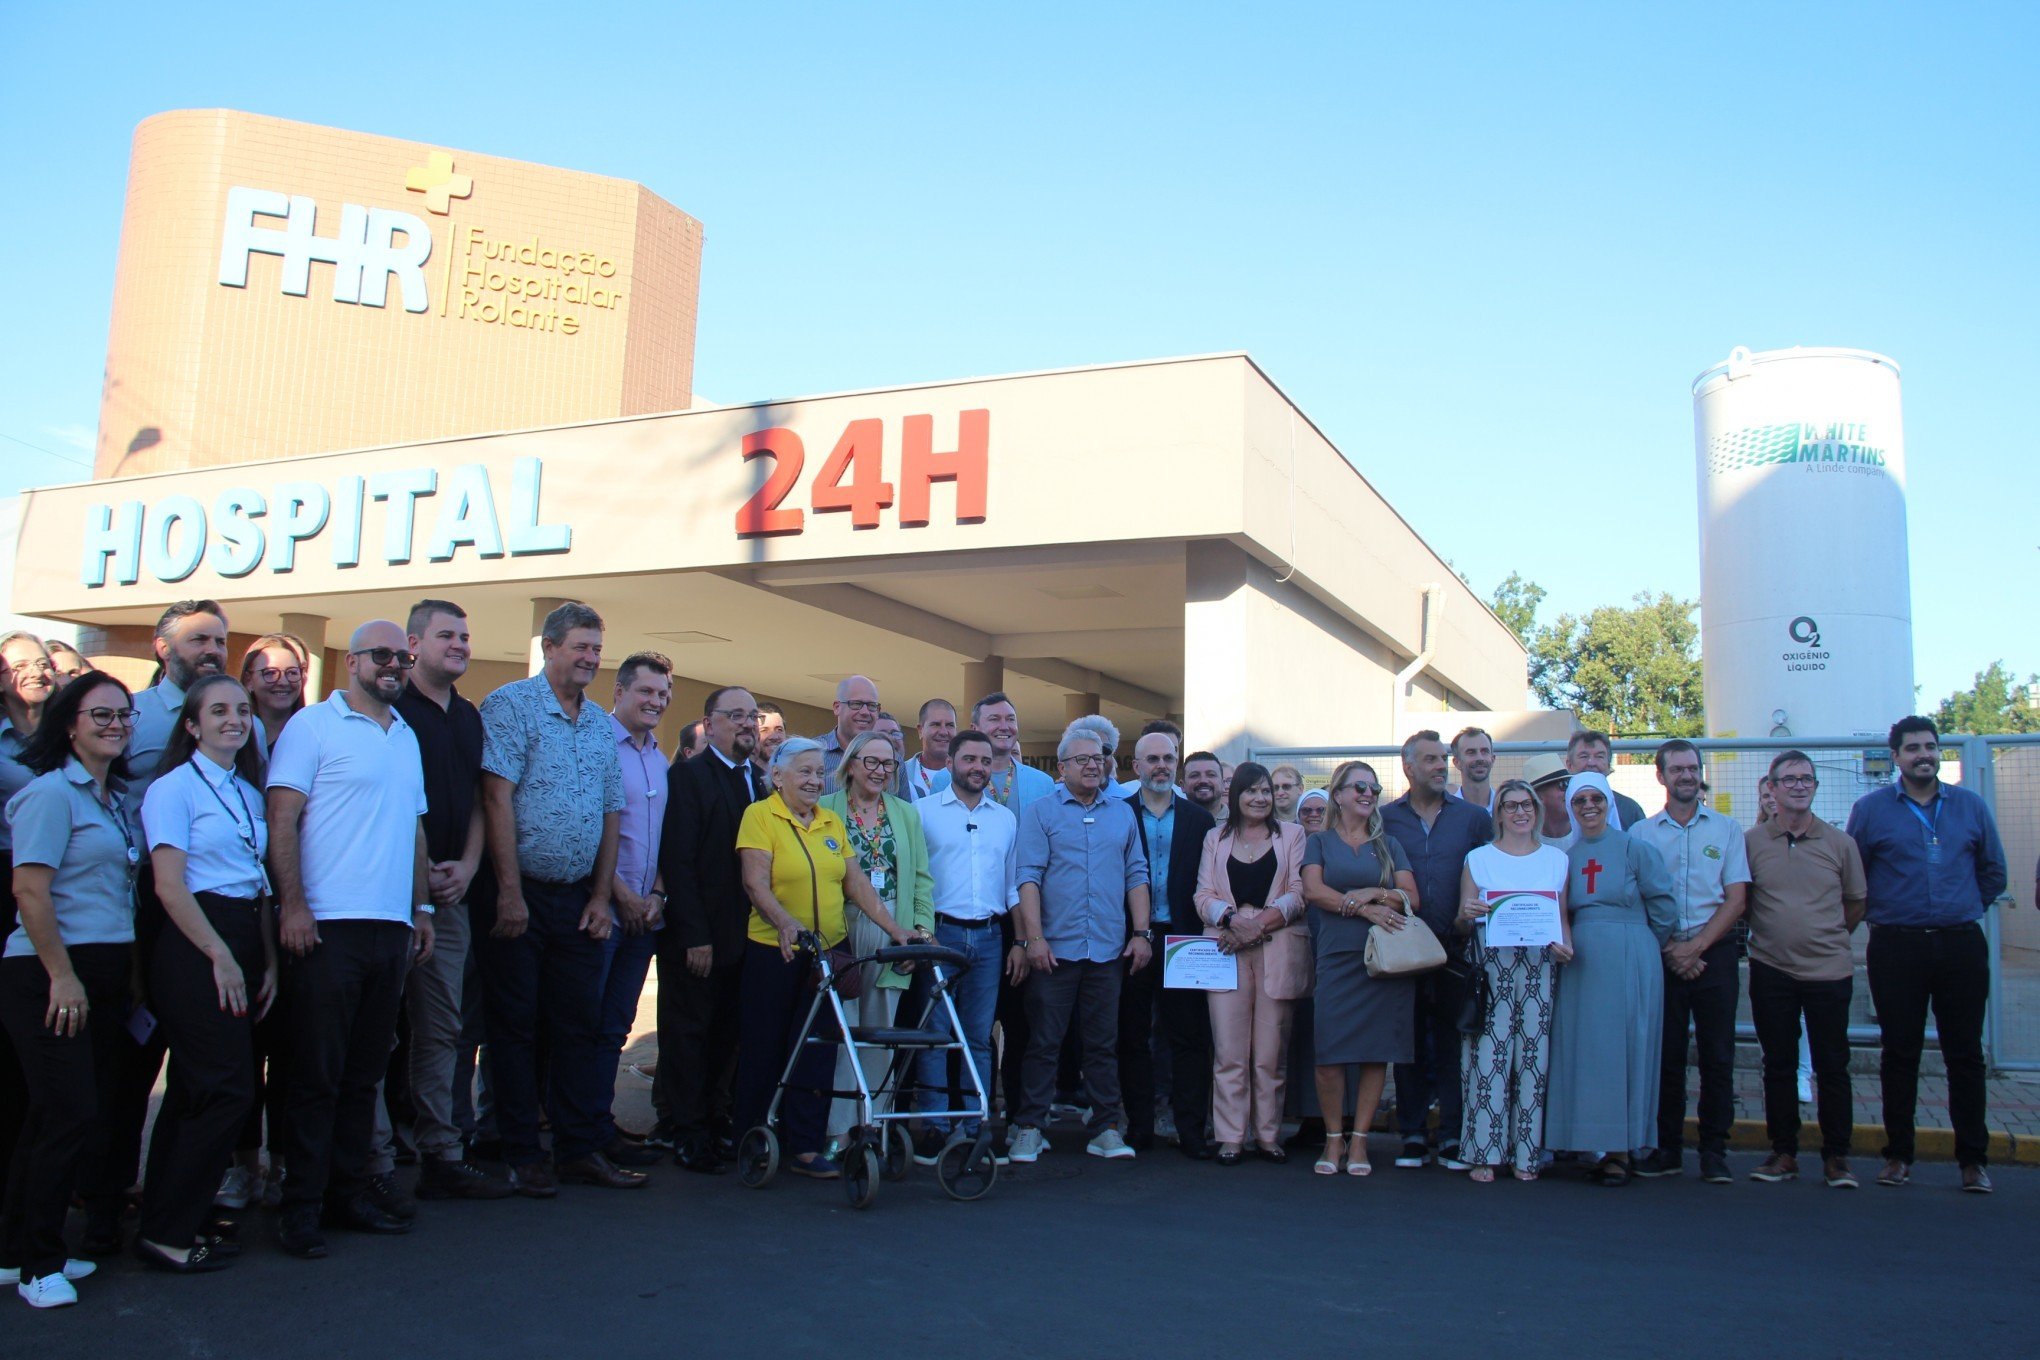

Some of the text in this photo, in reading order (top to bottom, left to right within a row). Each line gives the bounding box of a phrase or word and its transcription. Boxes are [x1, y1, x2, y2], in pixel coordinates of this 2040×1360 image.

[219, 186, 432, 314] FHR
[466, 226, 616, 278] Fundação
[463, 258, 622, 309] Hospitalar
[459, 287, 580, 335] Rolante
[1799, 444, 1885, 467] MARTINS
[1806, 462, 1885, 479] A Linde company
[81, 408, 990, 588] HOSPITAL 24H
